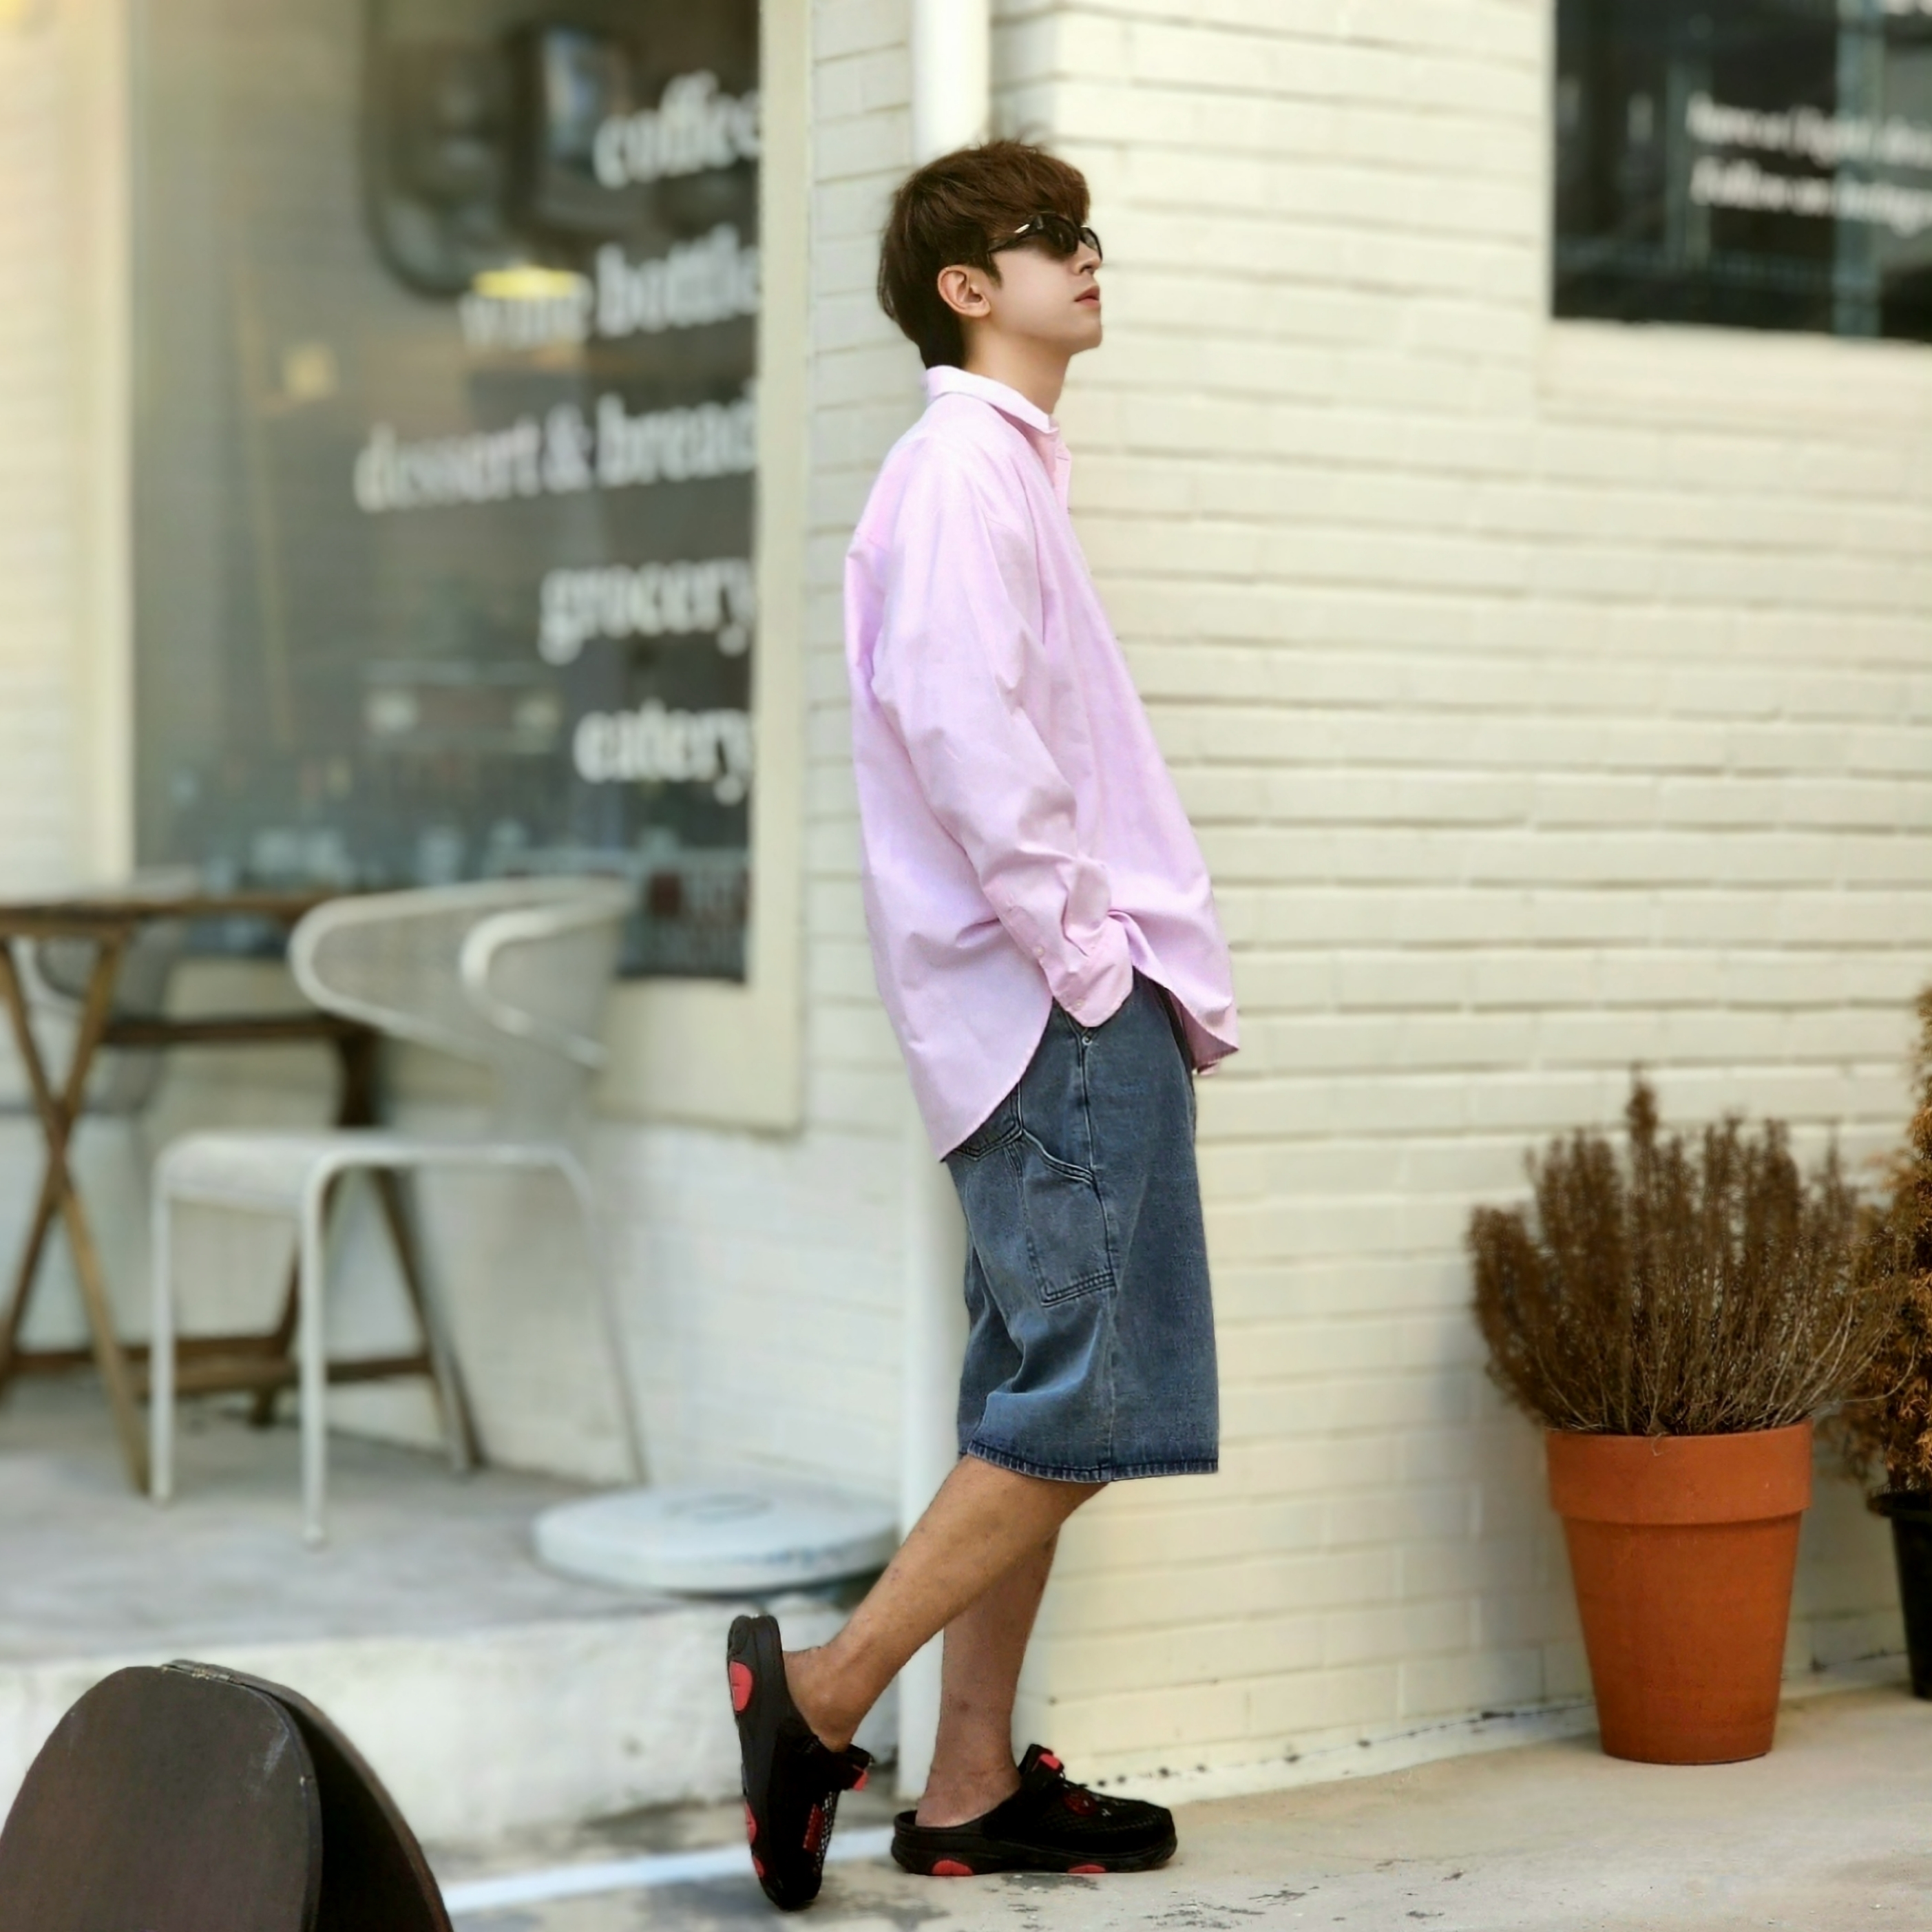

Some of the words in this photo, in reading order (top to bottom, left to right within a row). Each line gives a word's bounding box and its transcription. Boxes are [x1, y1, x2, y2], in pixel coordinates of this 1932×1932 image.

[355, 421, 540, 512] dessert
[543, 404, 593, 493] &
[539, 558, 753, 665] grocery
[574, 697, 753, 806] eatery
